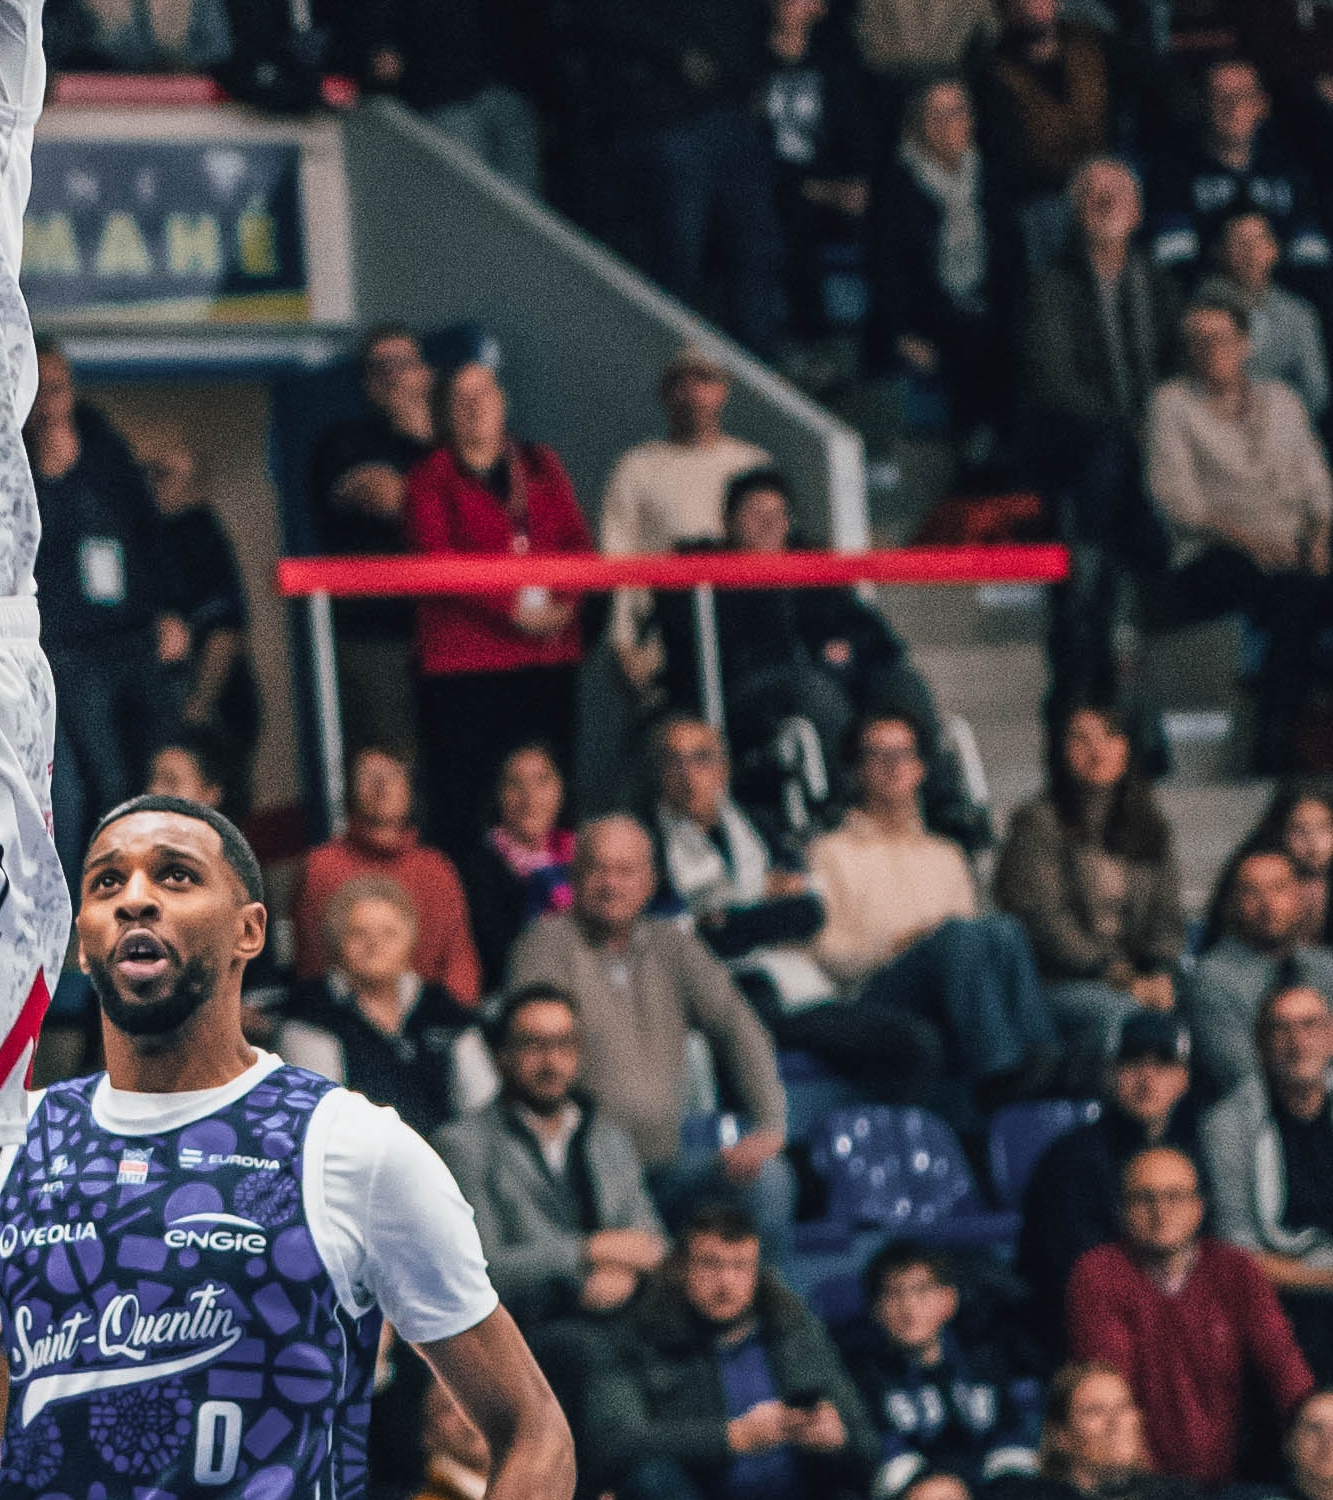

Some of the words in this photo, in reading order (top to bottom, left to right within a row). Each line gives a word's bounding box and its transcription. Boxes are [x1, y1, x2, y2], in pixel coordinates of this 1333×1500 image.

[208, 1153, 282, 1171] EUROVIA
[20, 1221, 98, 1247] VEOLIA
[9, 1284, 242, 1381] Saint-Quentin
[194, 1400, 243, 1486] 0
